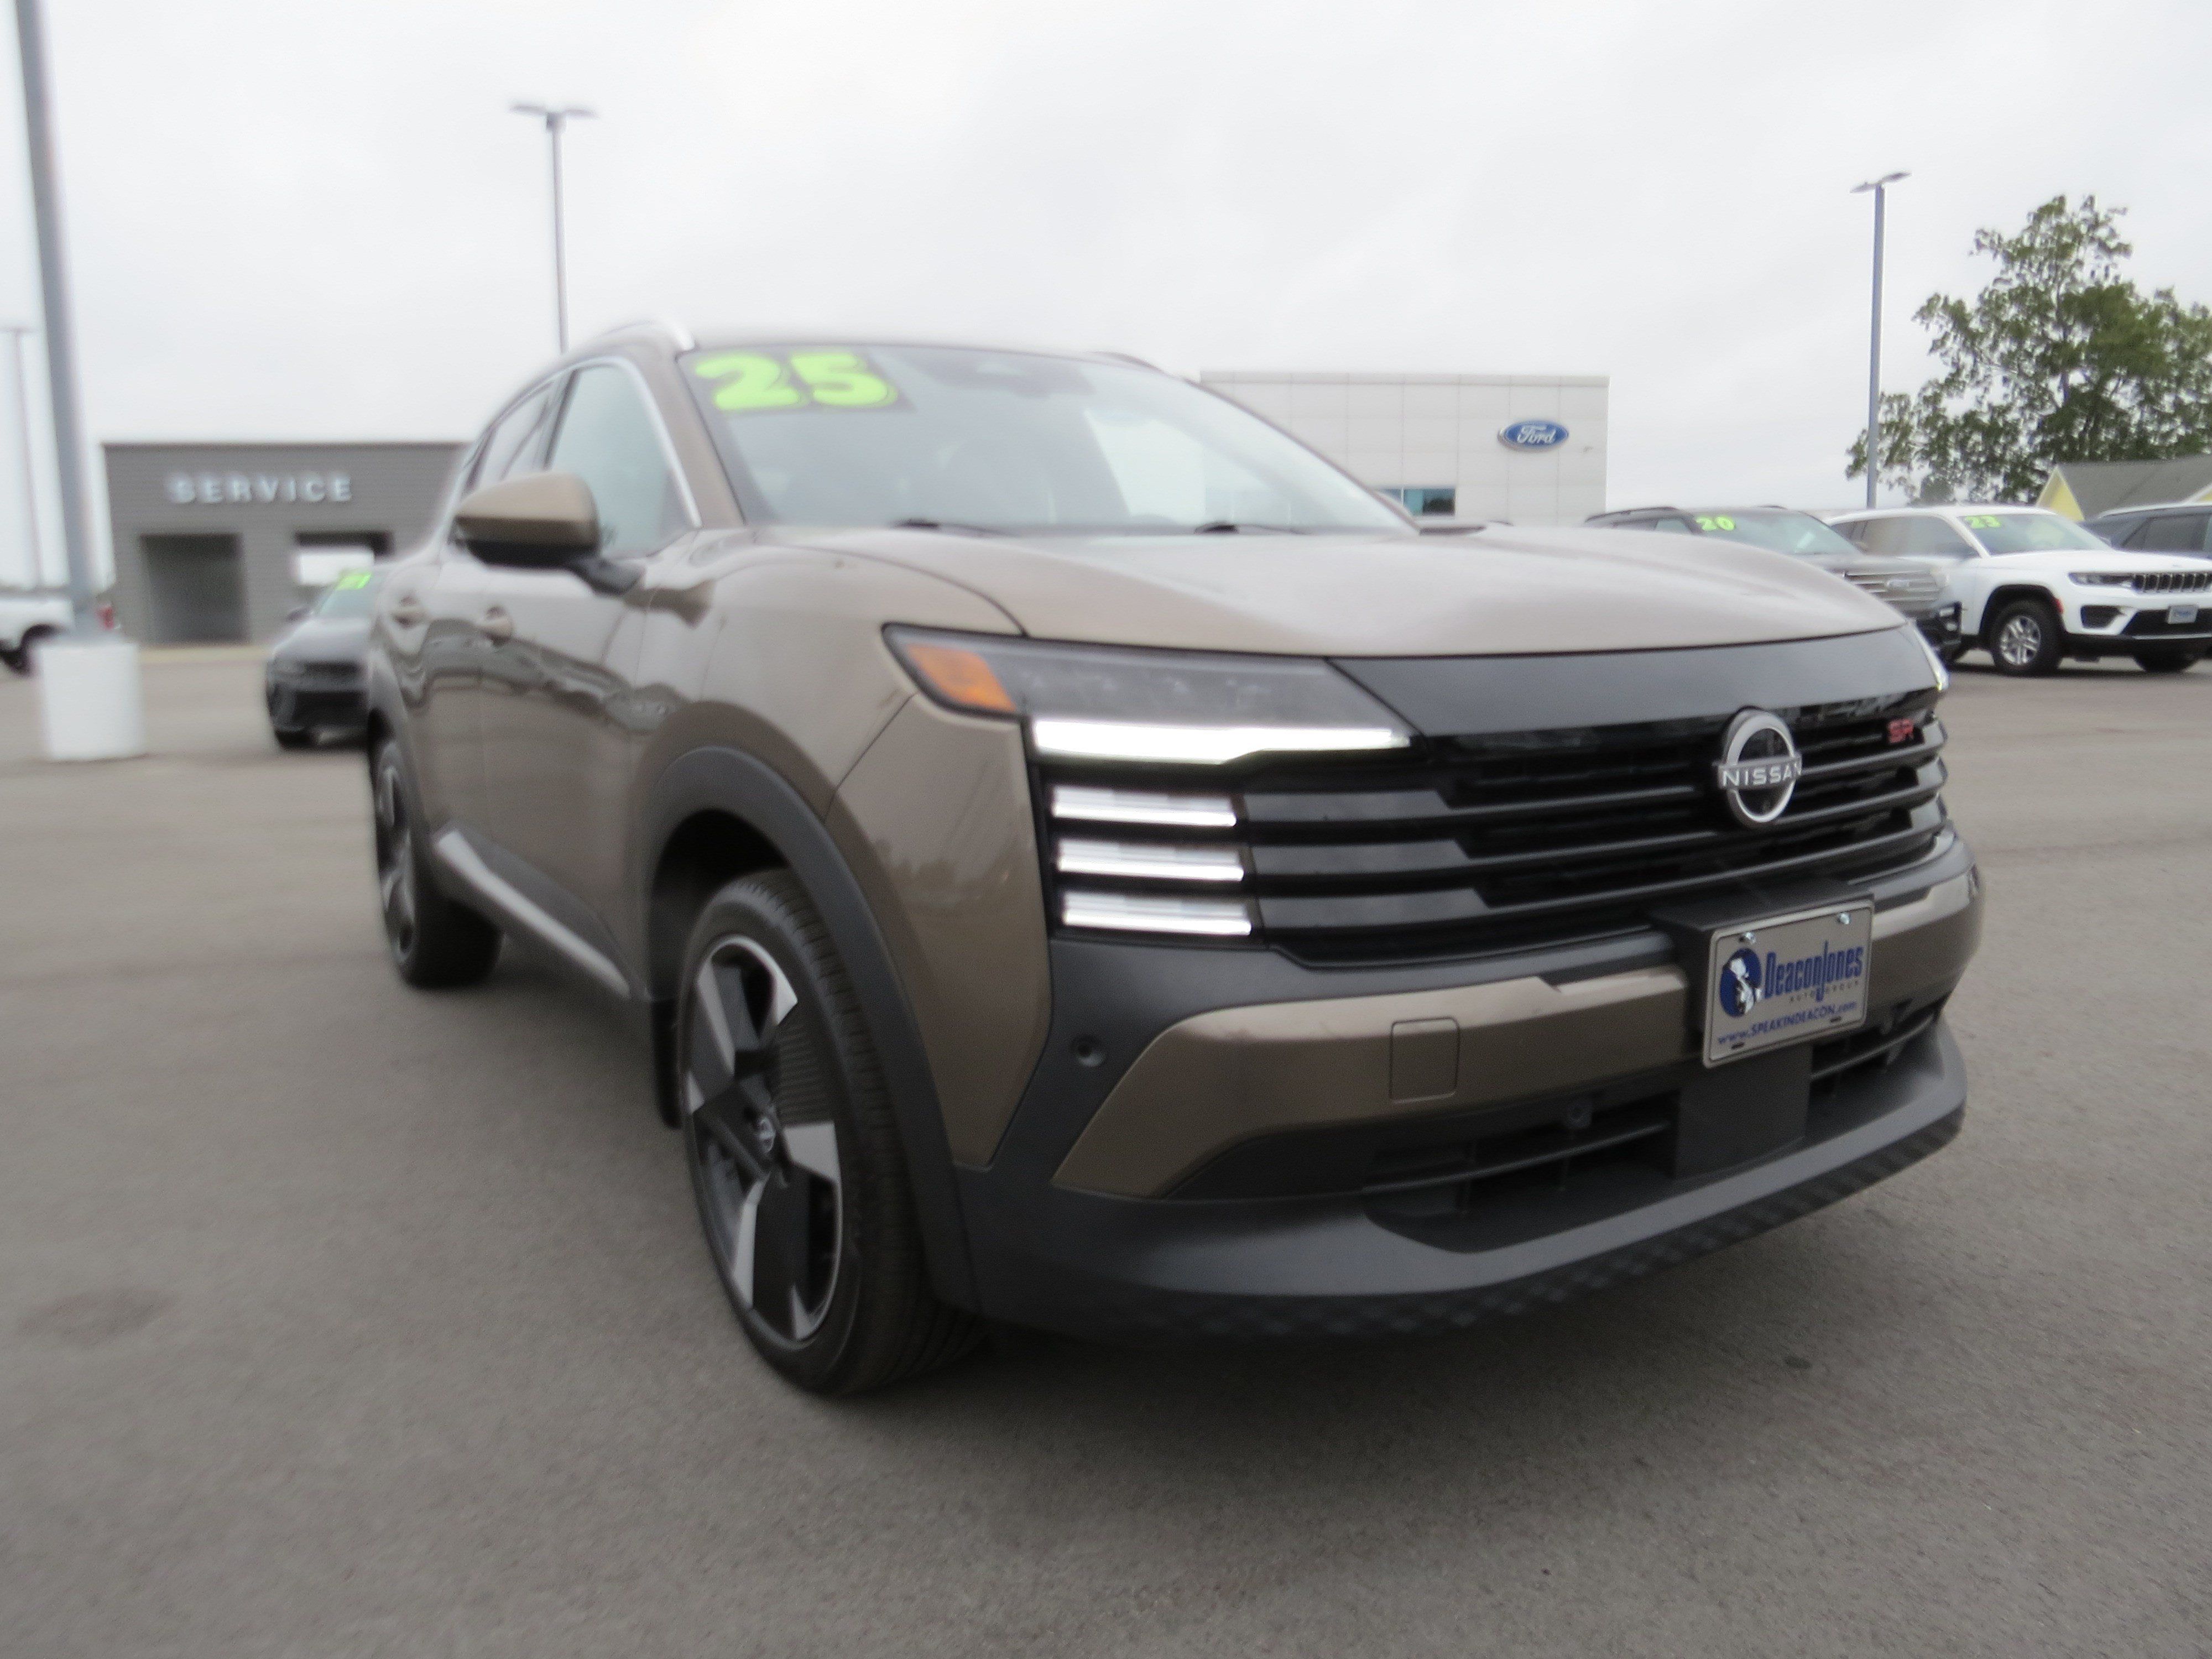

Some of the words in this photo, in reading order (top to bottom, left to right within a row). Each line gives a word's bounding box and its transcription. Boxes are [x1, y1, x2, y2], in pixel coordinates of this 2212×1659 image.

[695, 351, 898, 411] 25
[1517, 425, 1556, 444] Ford
[169, 472, 352, 503] SERVICE
[1696, 515, 1736, 531] 20
[1722, 761, 1802, 787] NISSAN
